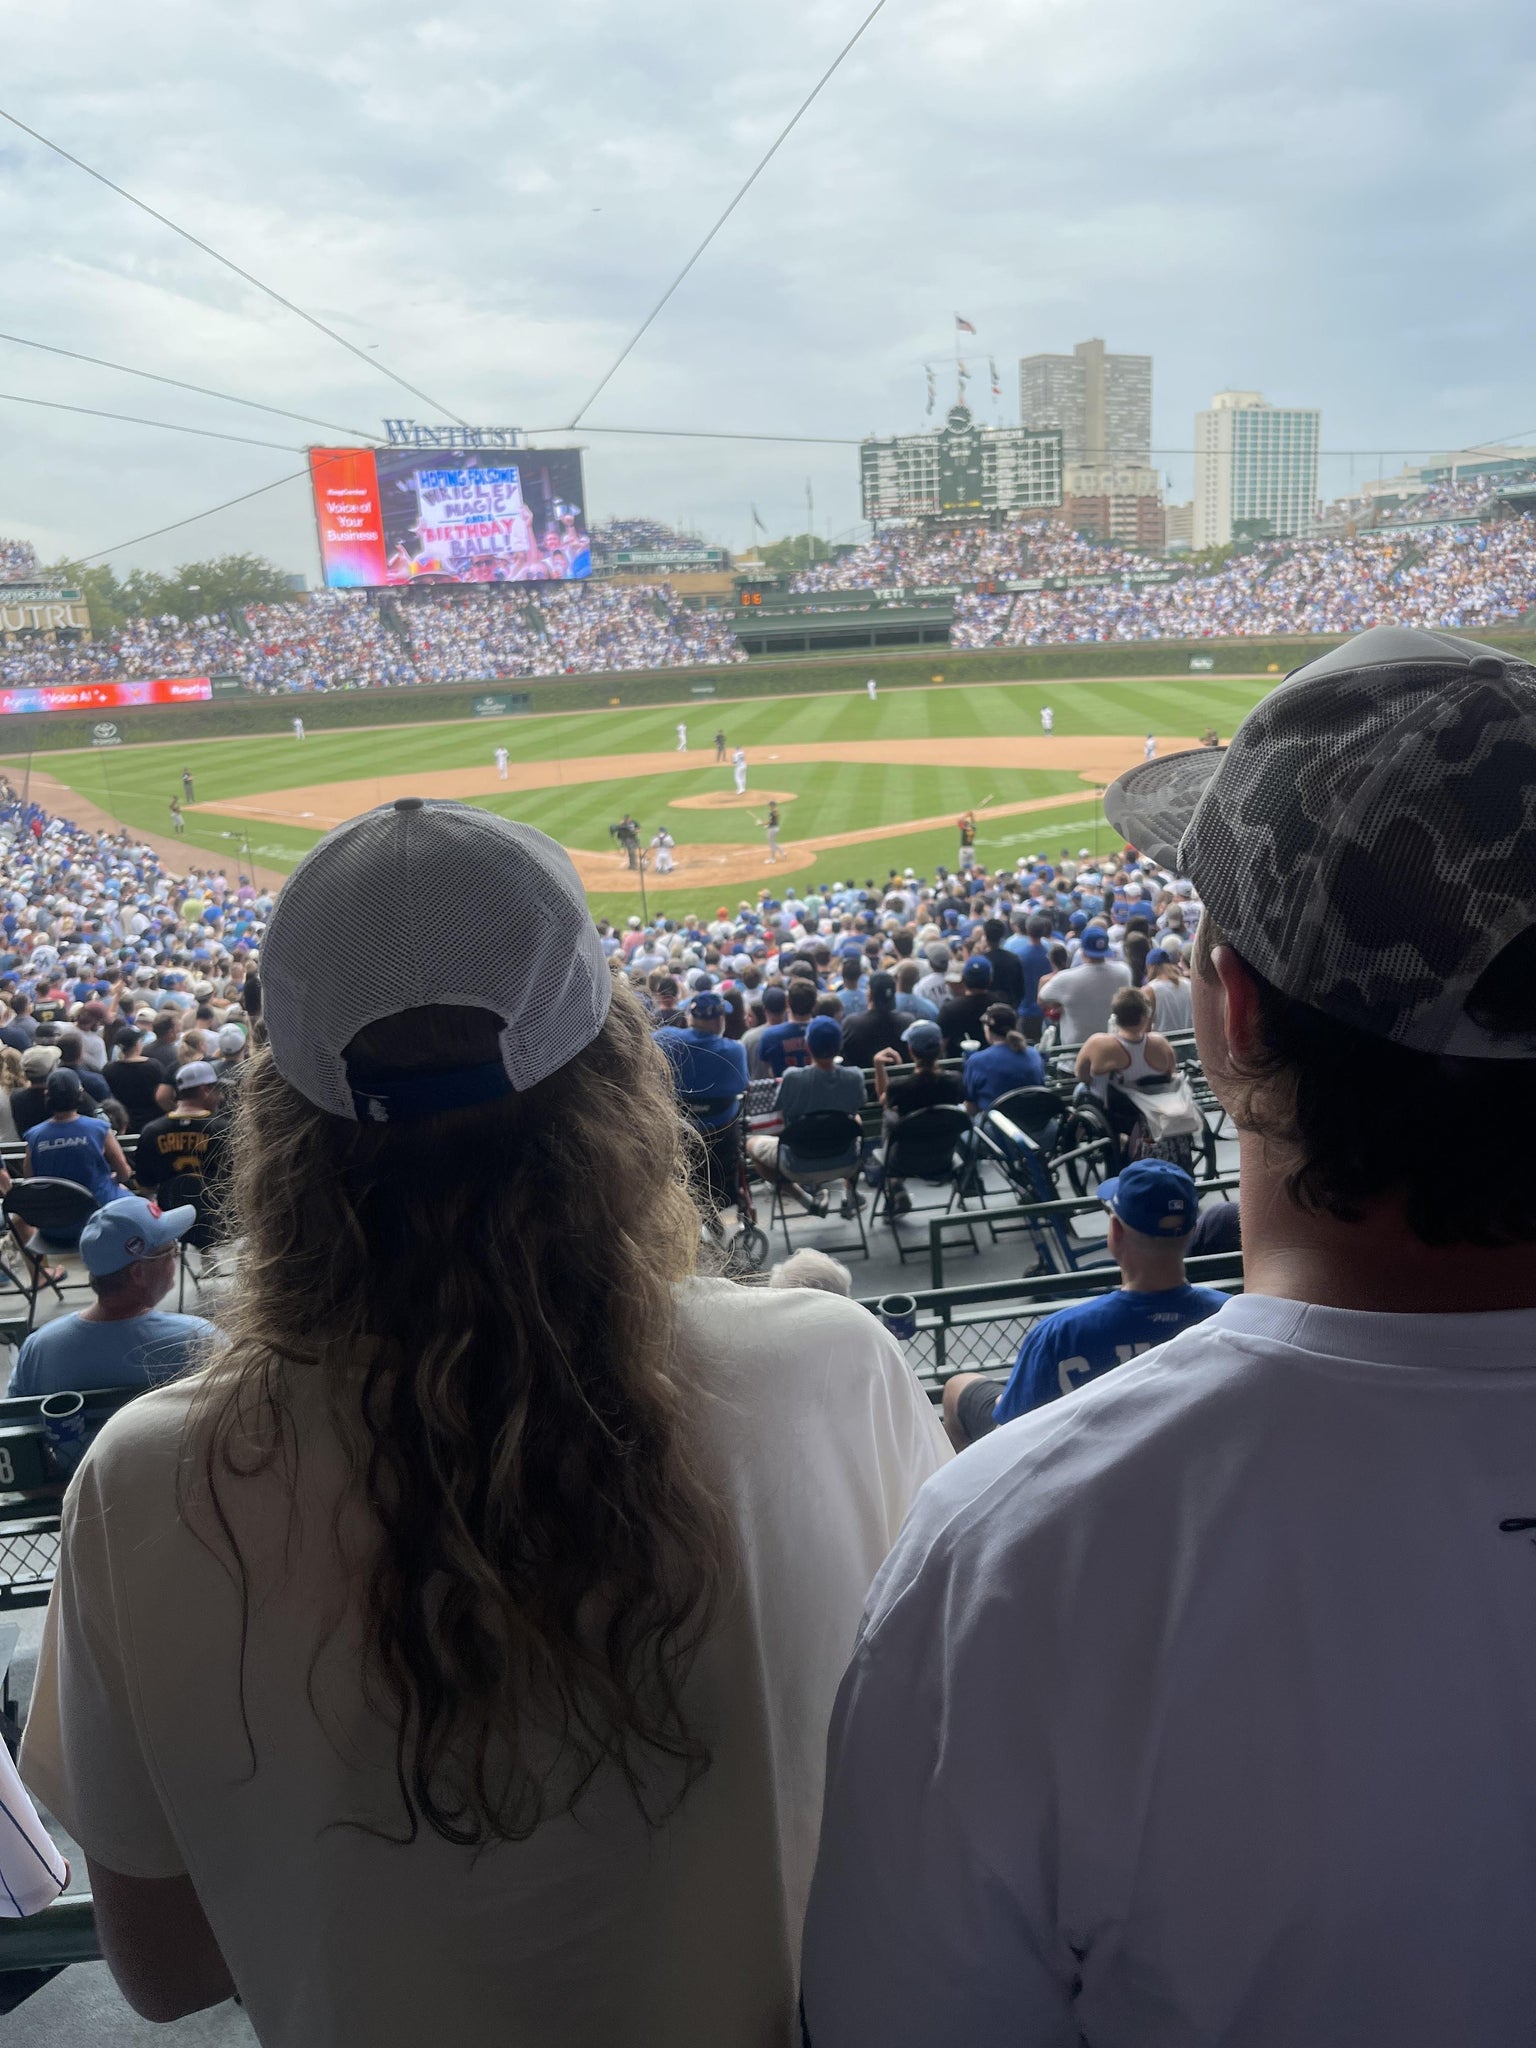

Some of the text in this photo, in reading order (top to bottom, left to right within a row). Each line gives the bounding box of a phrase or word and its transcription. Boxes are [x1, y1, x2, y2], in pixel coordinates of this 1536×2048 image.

[381, 419, 522, 447] WINTRUST
[423, 484, 518, 506] WRIGLEY
[325, 502, 357, 514] Voice
[445, 498, 506, 517] MAGIC
[337, 516, 364, 527] Your
[425, 518, 515, 542] BIRTHDAY
[327, 530, 378, 541] Business
[450, 534, 512, 556] BALL!
[873, 588, 905, 599] YETI
[0, 603, 85, 632] UTRL
[38, 1136, 87, 1152] SLOAN
[158, 1132, 209, 1154] GRIFFIN
